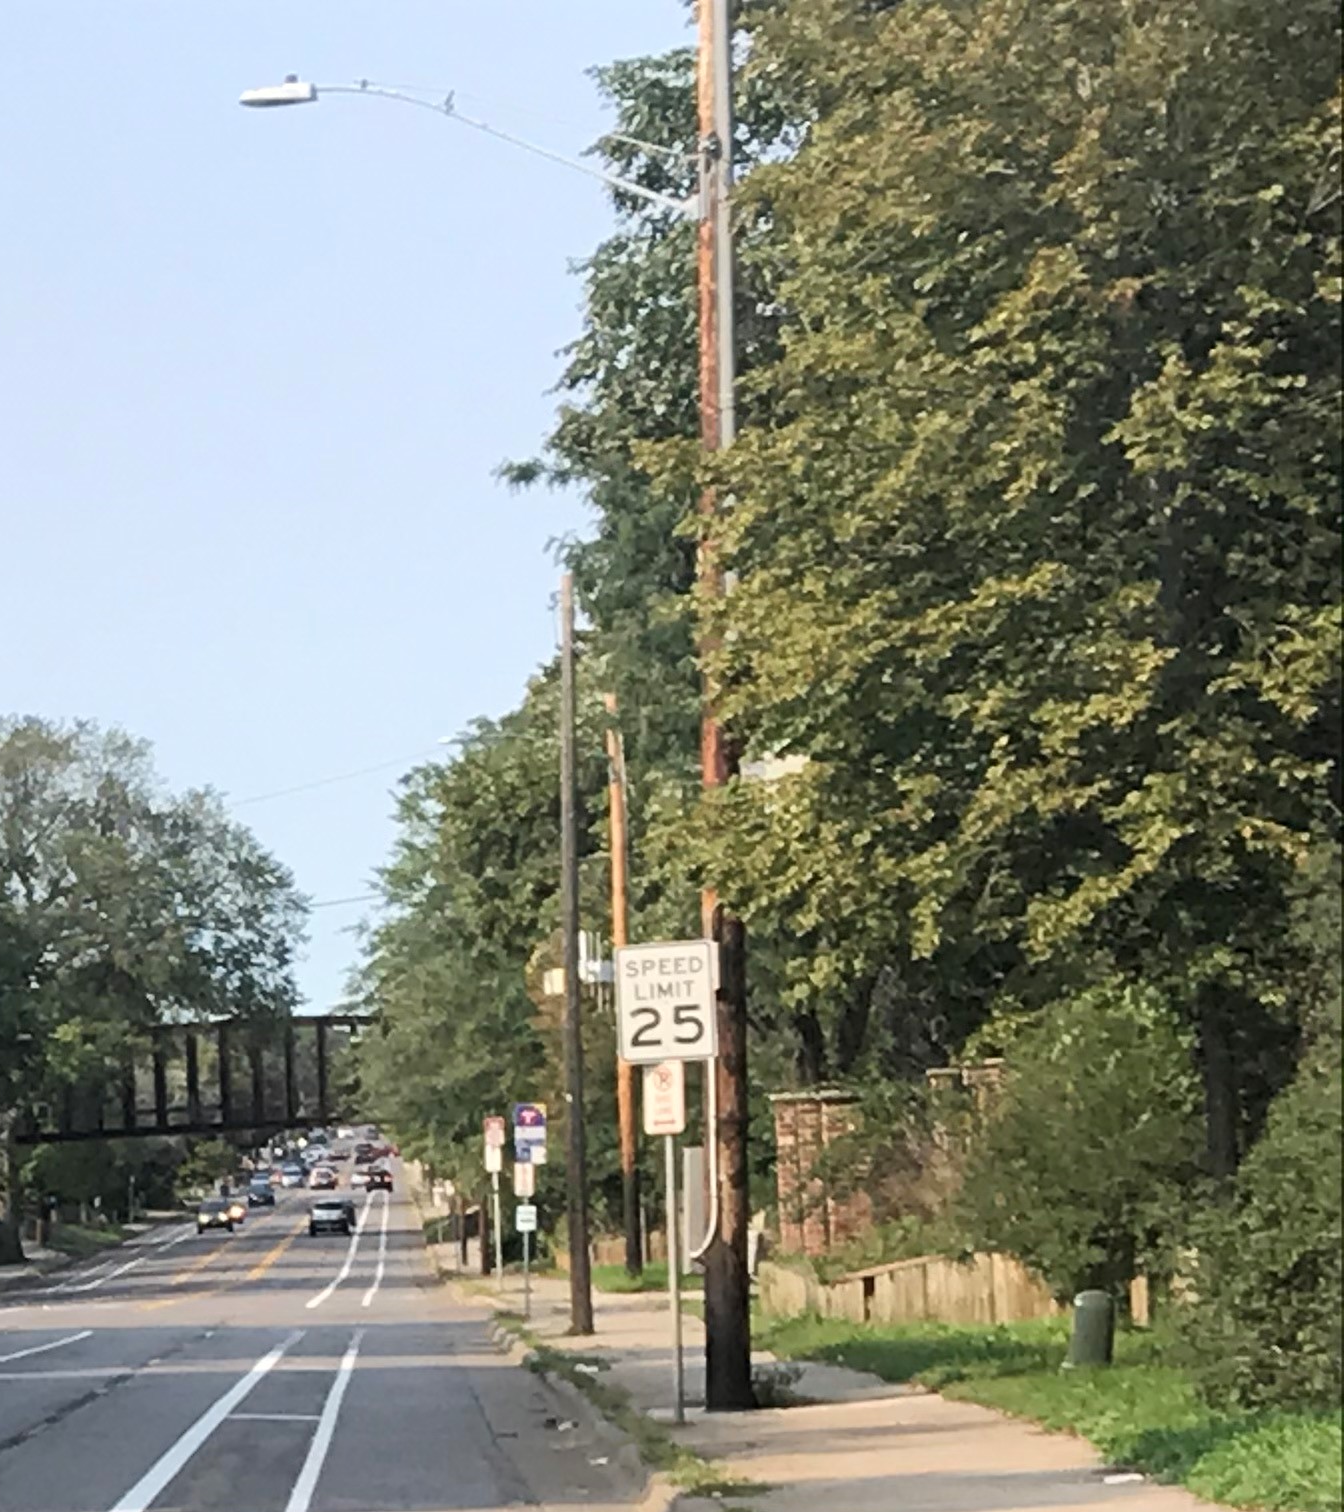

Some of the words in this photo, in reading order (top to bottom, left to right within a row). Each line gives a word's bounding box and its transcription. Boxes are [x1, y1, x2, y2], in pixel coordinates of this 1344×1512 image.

[625, 956, 703, 978] SPEED
[635, 980, 694, 1001] LIMIT
[629, 1004, 704, 1048] 25
